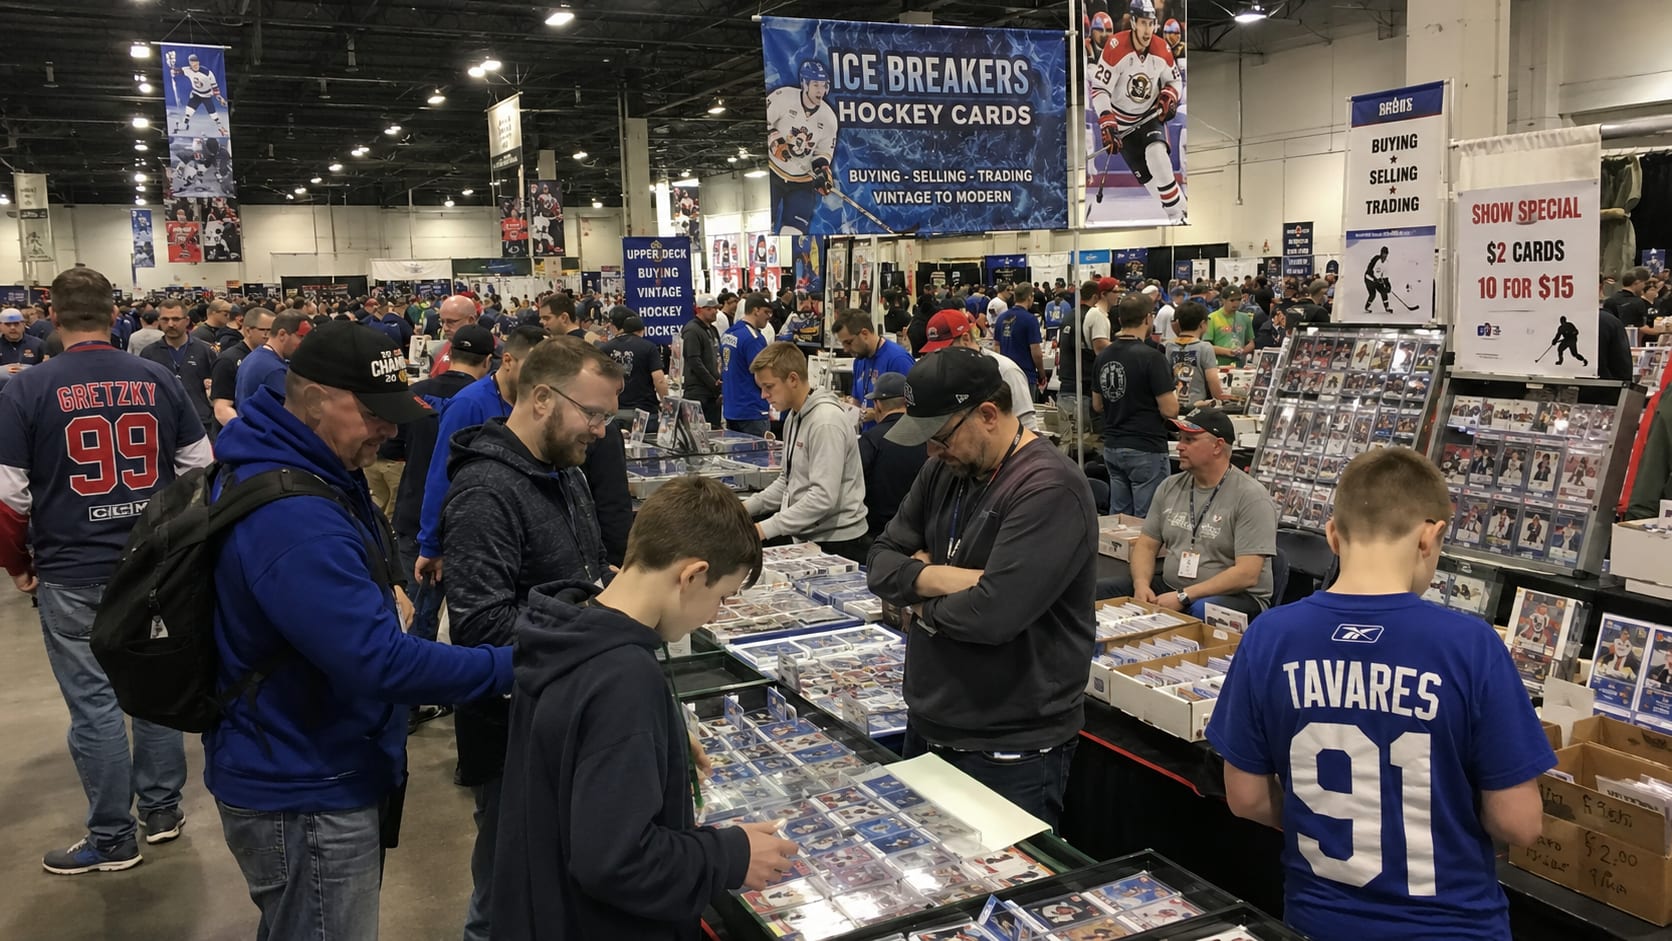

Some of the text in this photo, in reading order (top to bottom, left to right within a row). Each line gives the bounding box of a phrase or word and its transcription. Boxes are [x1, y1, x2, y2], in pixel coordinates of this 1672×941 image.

[832, 53, 1030, 95] ICE BREAKERS
[1095, 64, 1112, 85] 29
[839, 101, 1032, 126] HOCKEY CARDS
[1371, 133, 1418, 154] BUYING
[849, 169, 900, 183] BUYING
[913, 170, 967, 183] SELLING
[977, 169, 1033, 182] TRADING
[1369, 165, 1418, 185] SELLING
[873, 190, 1012, 204] VINTAGE TO MODERN
[1365, 196, 1419, 215] TRADING
[1472, 196, 1582, 225] SHOW SPECIAL
[627, 248, 687, 260] UPPER DECK
[1487, 239, 1565, 266] $2 CARDS
[637, 267, 679, 279] BUYING
[637, 286, 682, 298] VINTAGE
[1478, 273, 1574, 301] 10 FOR $15
[638, 306, 682, 317] HOCKEY
[56, 380, 156, 413] GRETZKY
[65, 411, 160, 497] 99
[1283, 659, 1442, 721] TAVARES
[1289, 722, 1437, 896] 91
